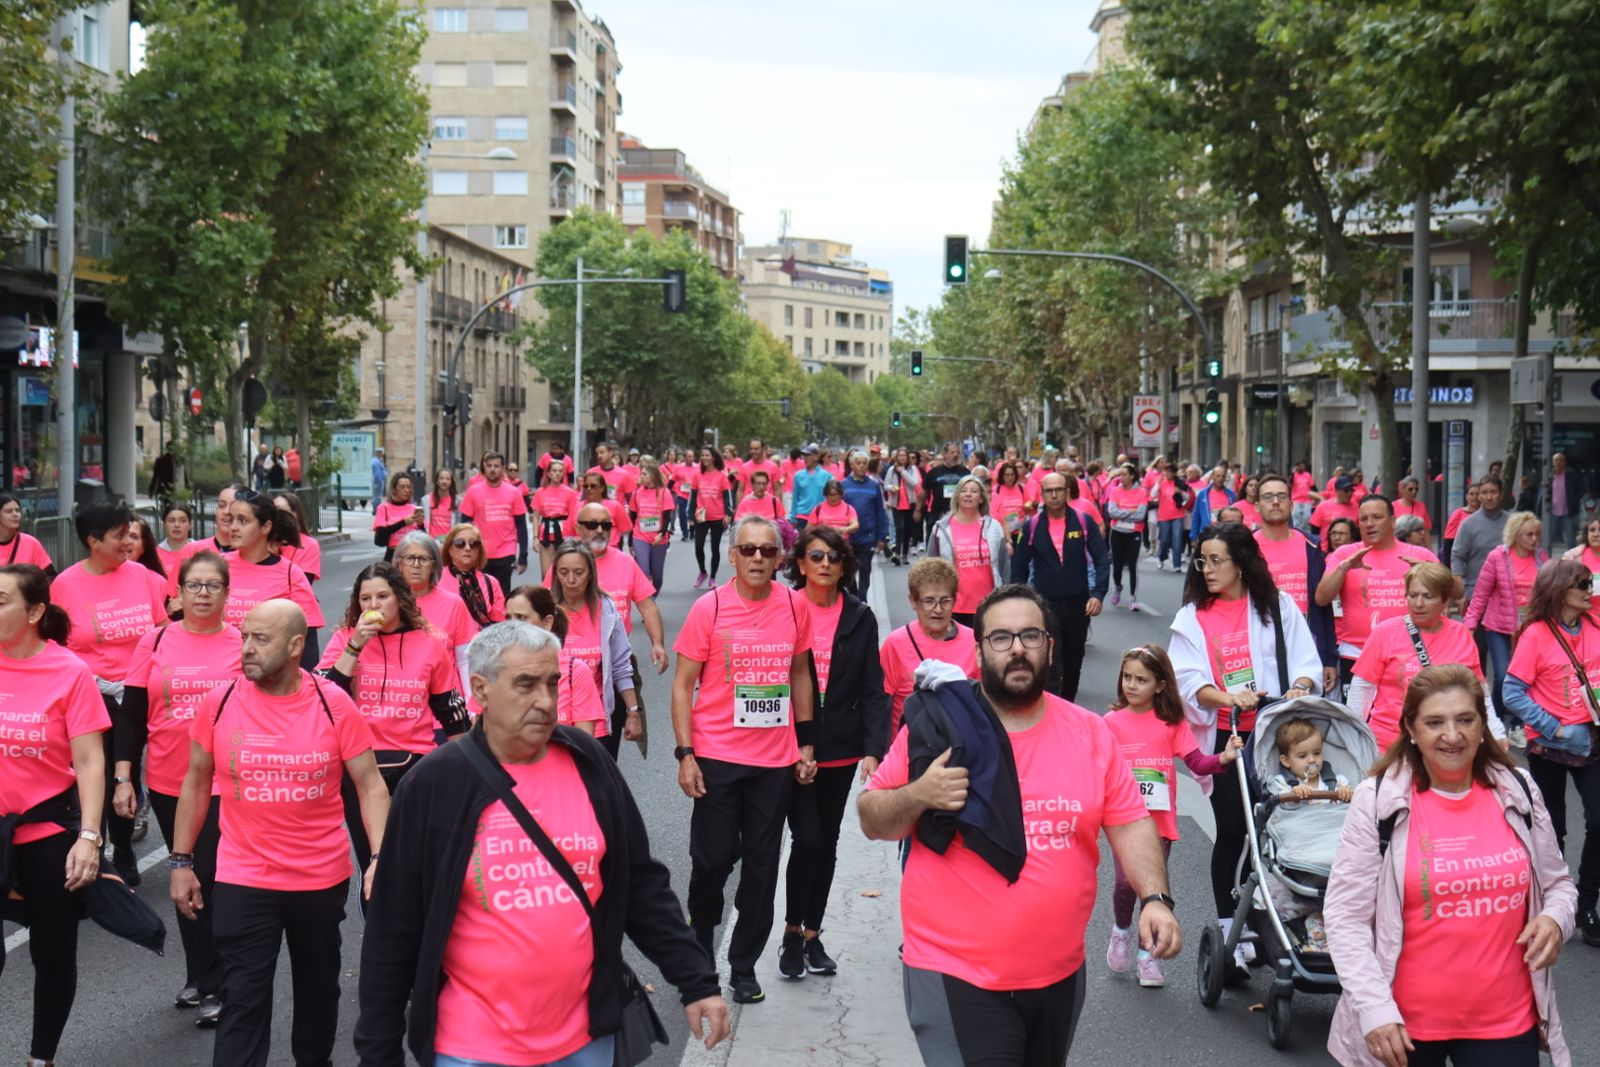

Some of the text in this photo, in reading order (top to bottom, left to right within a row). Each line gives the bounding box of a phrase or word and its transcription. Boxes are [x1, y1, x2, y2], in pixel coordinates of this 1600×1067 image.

[1370, 594, 1409, 607] cánc
[104, 622, 152, 641] cánce
[732, 641, 794, 653] En marcha
[1222, 645, 1238, 657] En
[1414, 640, 1431, 667] LOLA
[732, 655, 781, 668] contra
[1224, 656, 1250, 670] con
[171, 678, 189, 689] En
[360, 675, 426, 689] En marcha
[733, 668, 789, 683] cánce
[172, 692, 207, 703] cont
[359, 690, 412, 704] contra
[360, 702, 424, 719] cáncer
[744, 699, 781, 713] 10936
[0, 725, 48, 742] tra el
[0, 743, 48, 760] ncer
[240, 750, 330, 765] En marcha
[1134, 755, 1172, 767] marcha
[240, 765, 328, 783] contra el
[244, 782, 327, 803] cáncer
[1138, 782, 1154, 796] 62
[1024, 795, 1083, 813] archa
[1056, 816, 1078, 833] el
[486, 832, 599, 855] En mrcha
[572, 855, 596, 875] el
[1433, 845, 1528, 873] En marcha
[1434, 871, 1516, 896] contra
[493, 880, 594, 912] cáncr
[1436, 889, 1528, 919] cáncer
